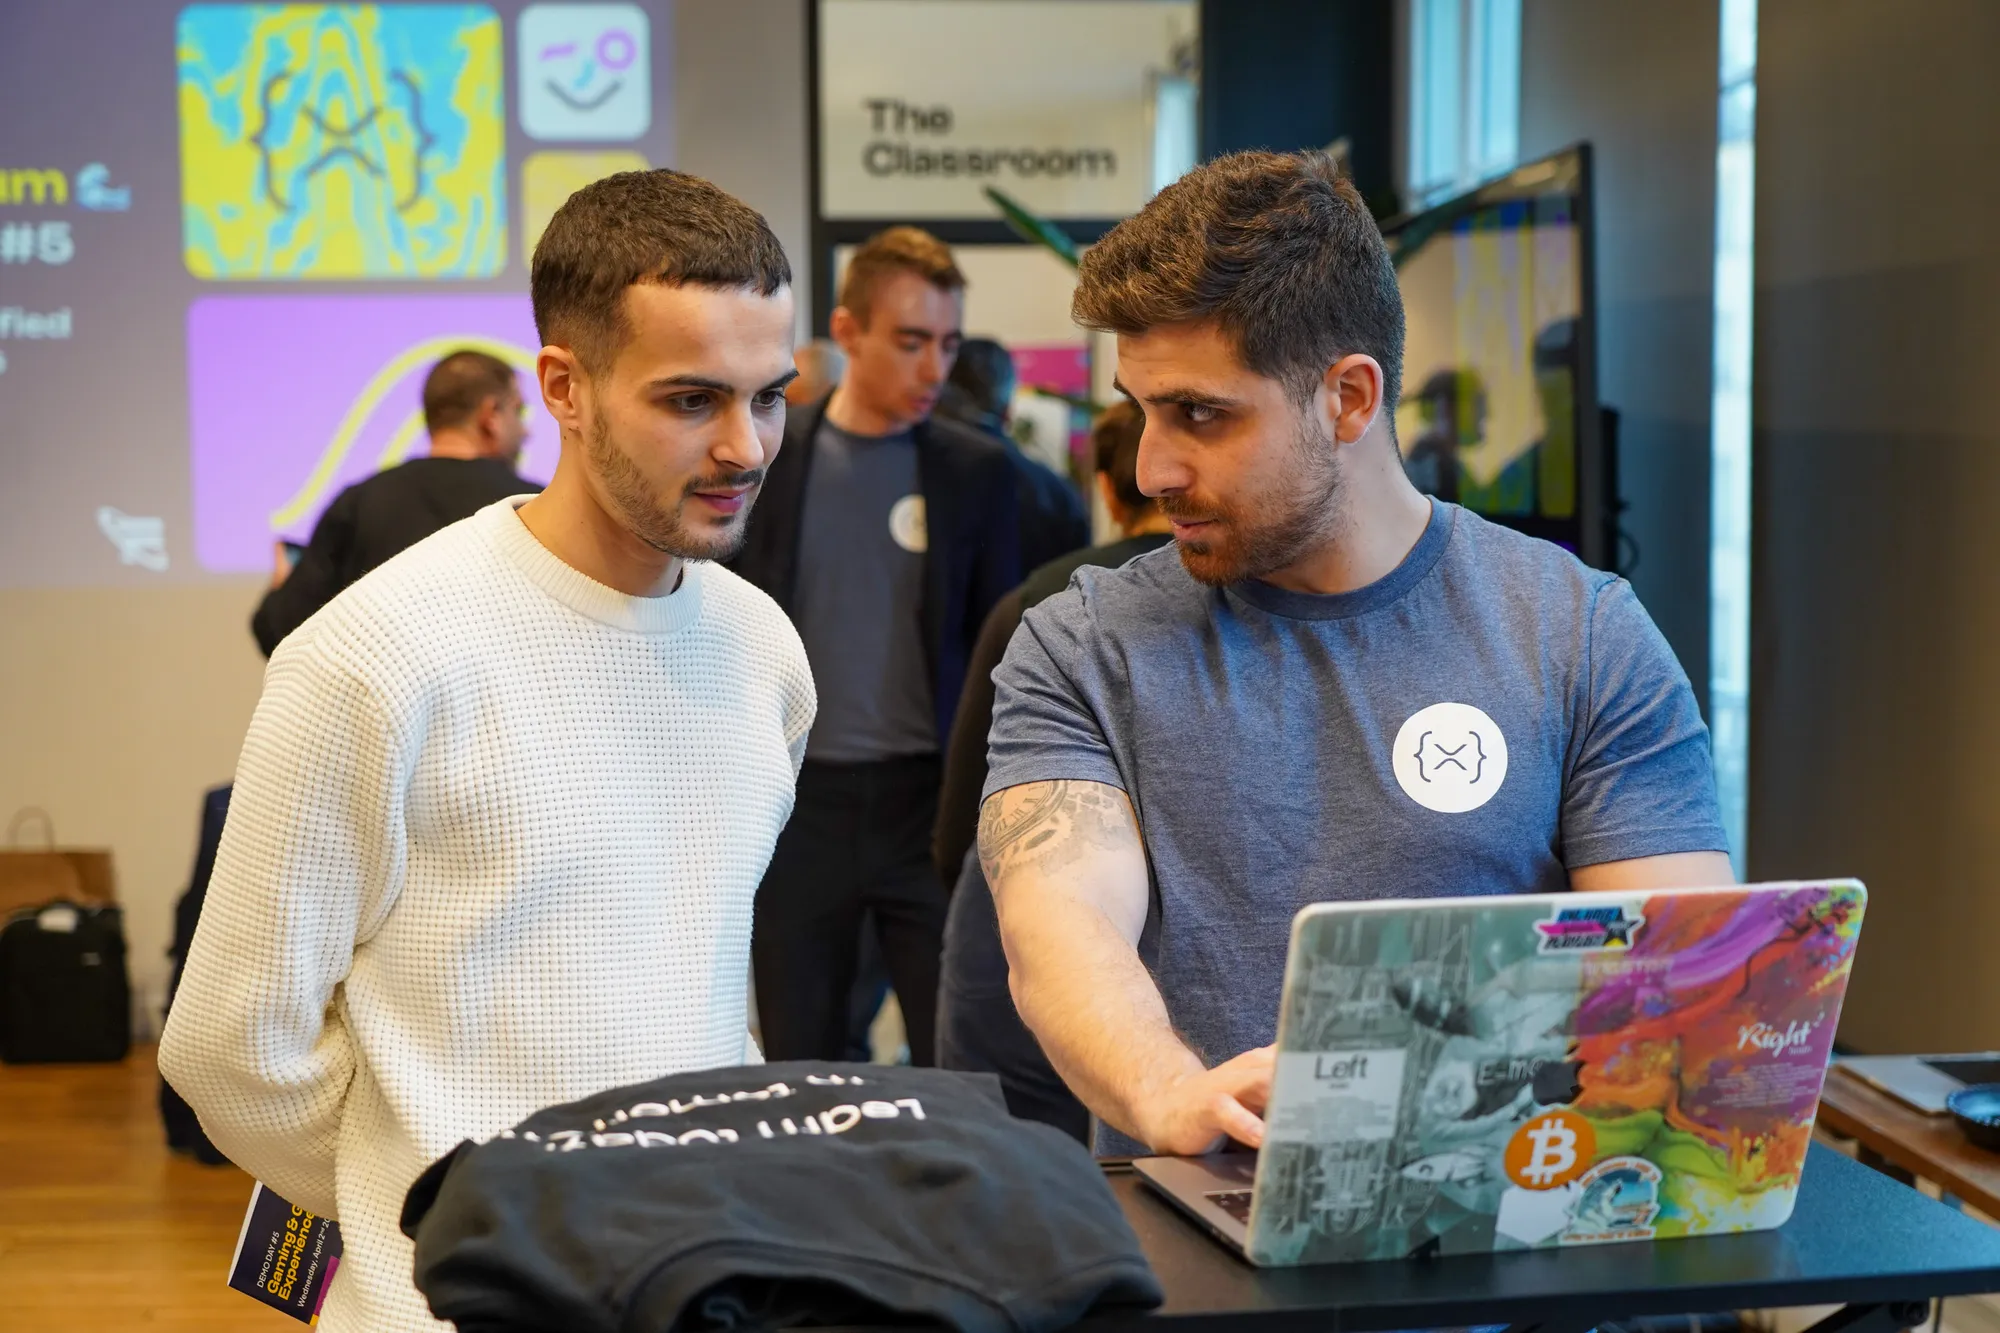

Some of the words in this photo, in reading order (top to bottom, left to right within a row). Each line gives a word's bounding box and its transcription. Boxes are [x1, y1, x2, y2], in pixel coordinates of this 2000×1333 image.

[863, 97, 953, 136] The
[863, 142, 1117, 178] Classroom
[0, 221, 75, 265] #5
[1737, 1019, 1811, 1058] Right
[1314, 1053, 1369, 1080] Left
[256, 1261, 271, 1288] DEMO
[265, 1245, 277, 1262] DAY
[272, 1231, 280, 1245] #5
[267, 1232, 296, 1294] Gaming
[286, 1217, 298, 1232] &
[278, 1209, 315, 1300] Experience
[297, 1256, 320, 1308] Wednesday,
[312, 1238, 324, 1259] April
